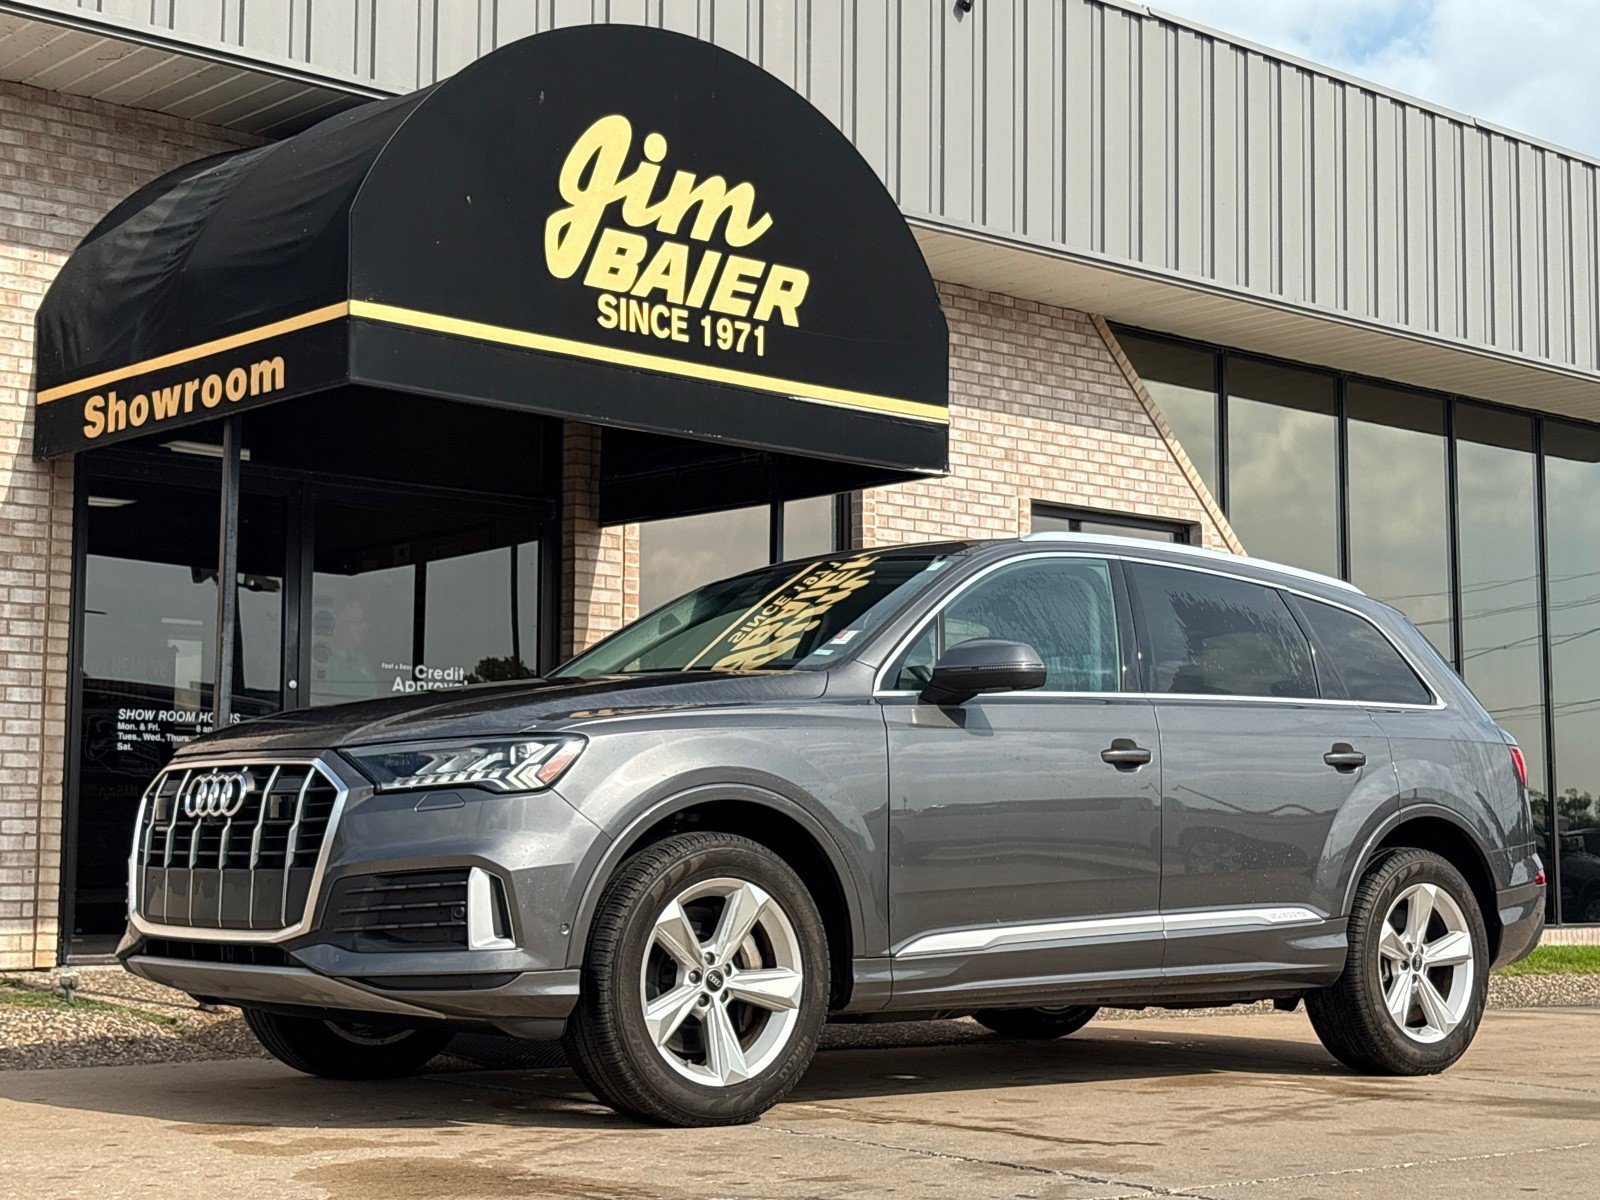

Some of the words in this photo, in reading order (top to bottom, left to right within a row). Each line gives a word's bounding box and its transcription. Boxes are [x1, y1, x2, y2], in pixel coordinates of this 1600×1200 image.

[584, 228, 809, 327] BAIER
[597, 294, 690, 342] SINCE
[701, 315, 764, 356] 1971
[83, 356, 285, 438] Showroom
[415, 664, 465, 681] Credit
[118, 708, 156, 720] SHOW
[158, 710, 196, 722] ROOM
[117, 722, 137, 731] Mon.
[140, 723, 145, 731] &
[148, 723, 160, 731] Fri.
[117, 742, 133, 751] Sat.
